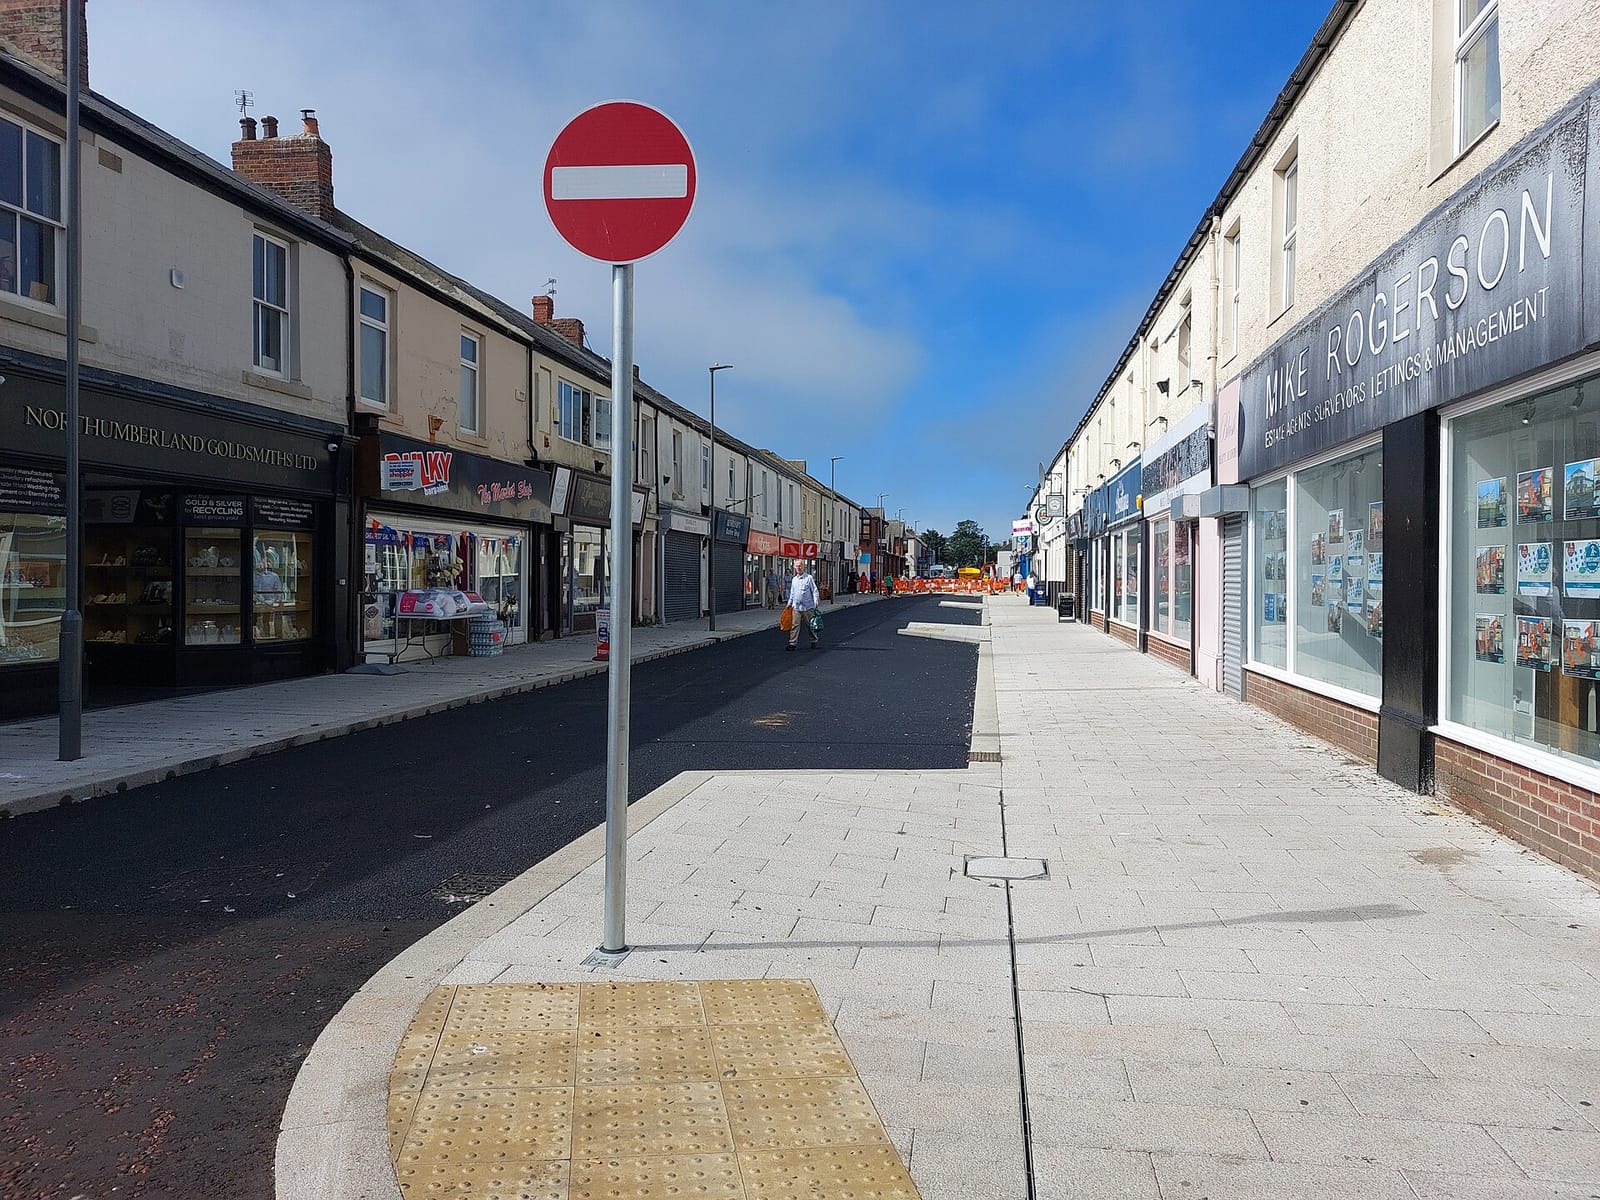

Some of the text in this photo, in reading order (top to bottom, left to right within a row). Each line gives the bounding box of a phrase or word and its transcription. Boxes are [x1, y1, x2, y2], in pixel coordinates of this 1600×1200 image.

[1265, 172, 1553, 419] MIKE ROGERSON
[1287, 409, 1312, 437] AGENTS
[1314, 382, 1366, 423] SURVEYORS
[1424, 346, 1432, 372] &
[1436, 286, 1550, 367] MANAGEMENT
[207, 438, 293, 468] GOLDSMITHS
[295, 453, 318, 471] LTD
[185, 498, 208, 506] GOLD
[215, 500, 243, 508] SILVER
[192, 506, 244, 516] RECYCLING
